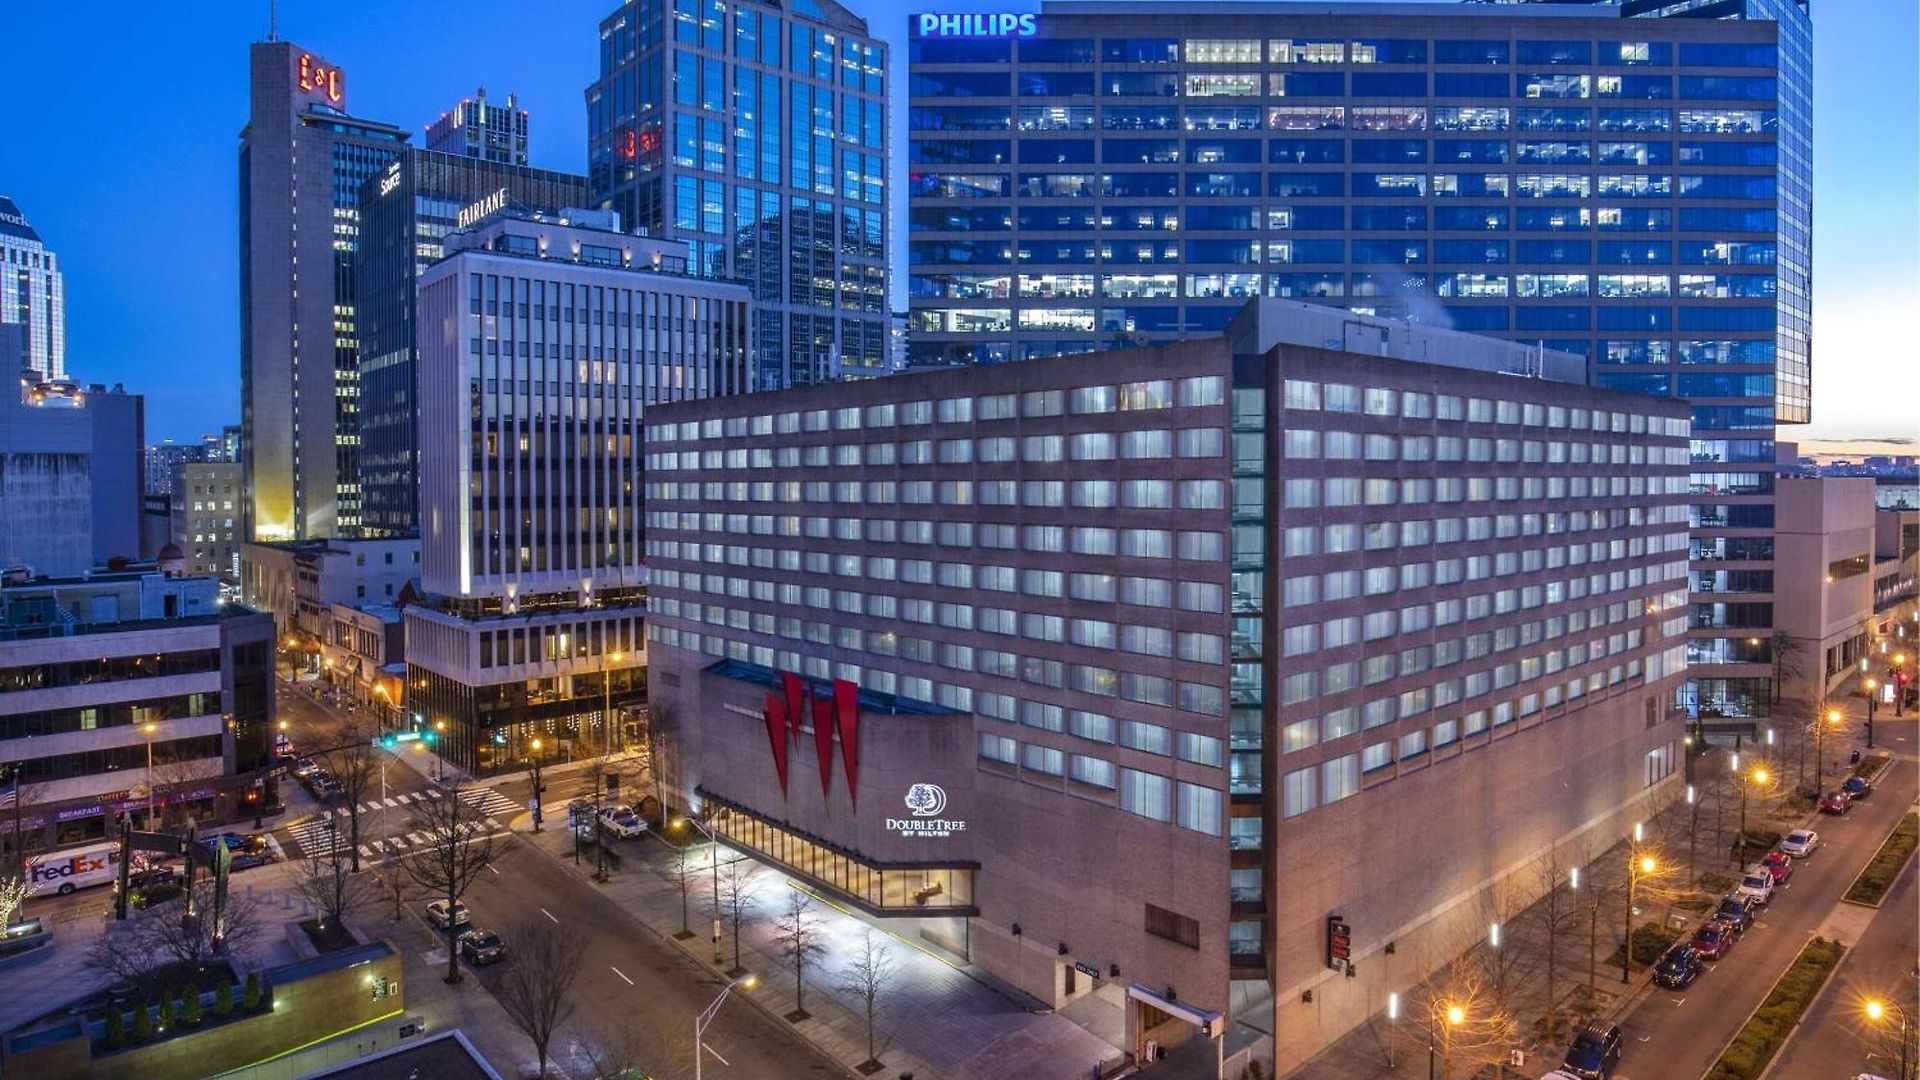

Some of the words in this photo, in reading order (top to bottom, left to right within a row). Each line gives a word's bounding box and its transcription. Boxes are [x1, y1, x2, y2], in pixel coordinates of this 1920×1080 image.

[920, 13, 1037, 36] PHILIPS
[458, 187, 506, 229] FAIRLANE
[59, 805, 101, 819] BREAKFAST
[30, 855, 104, 882] FedEx
